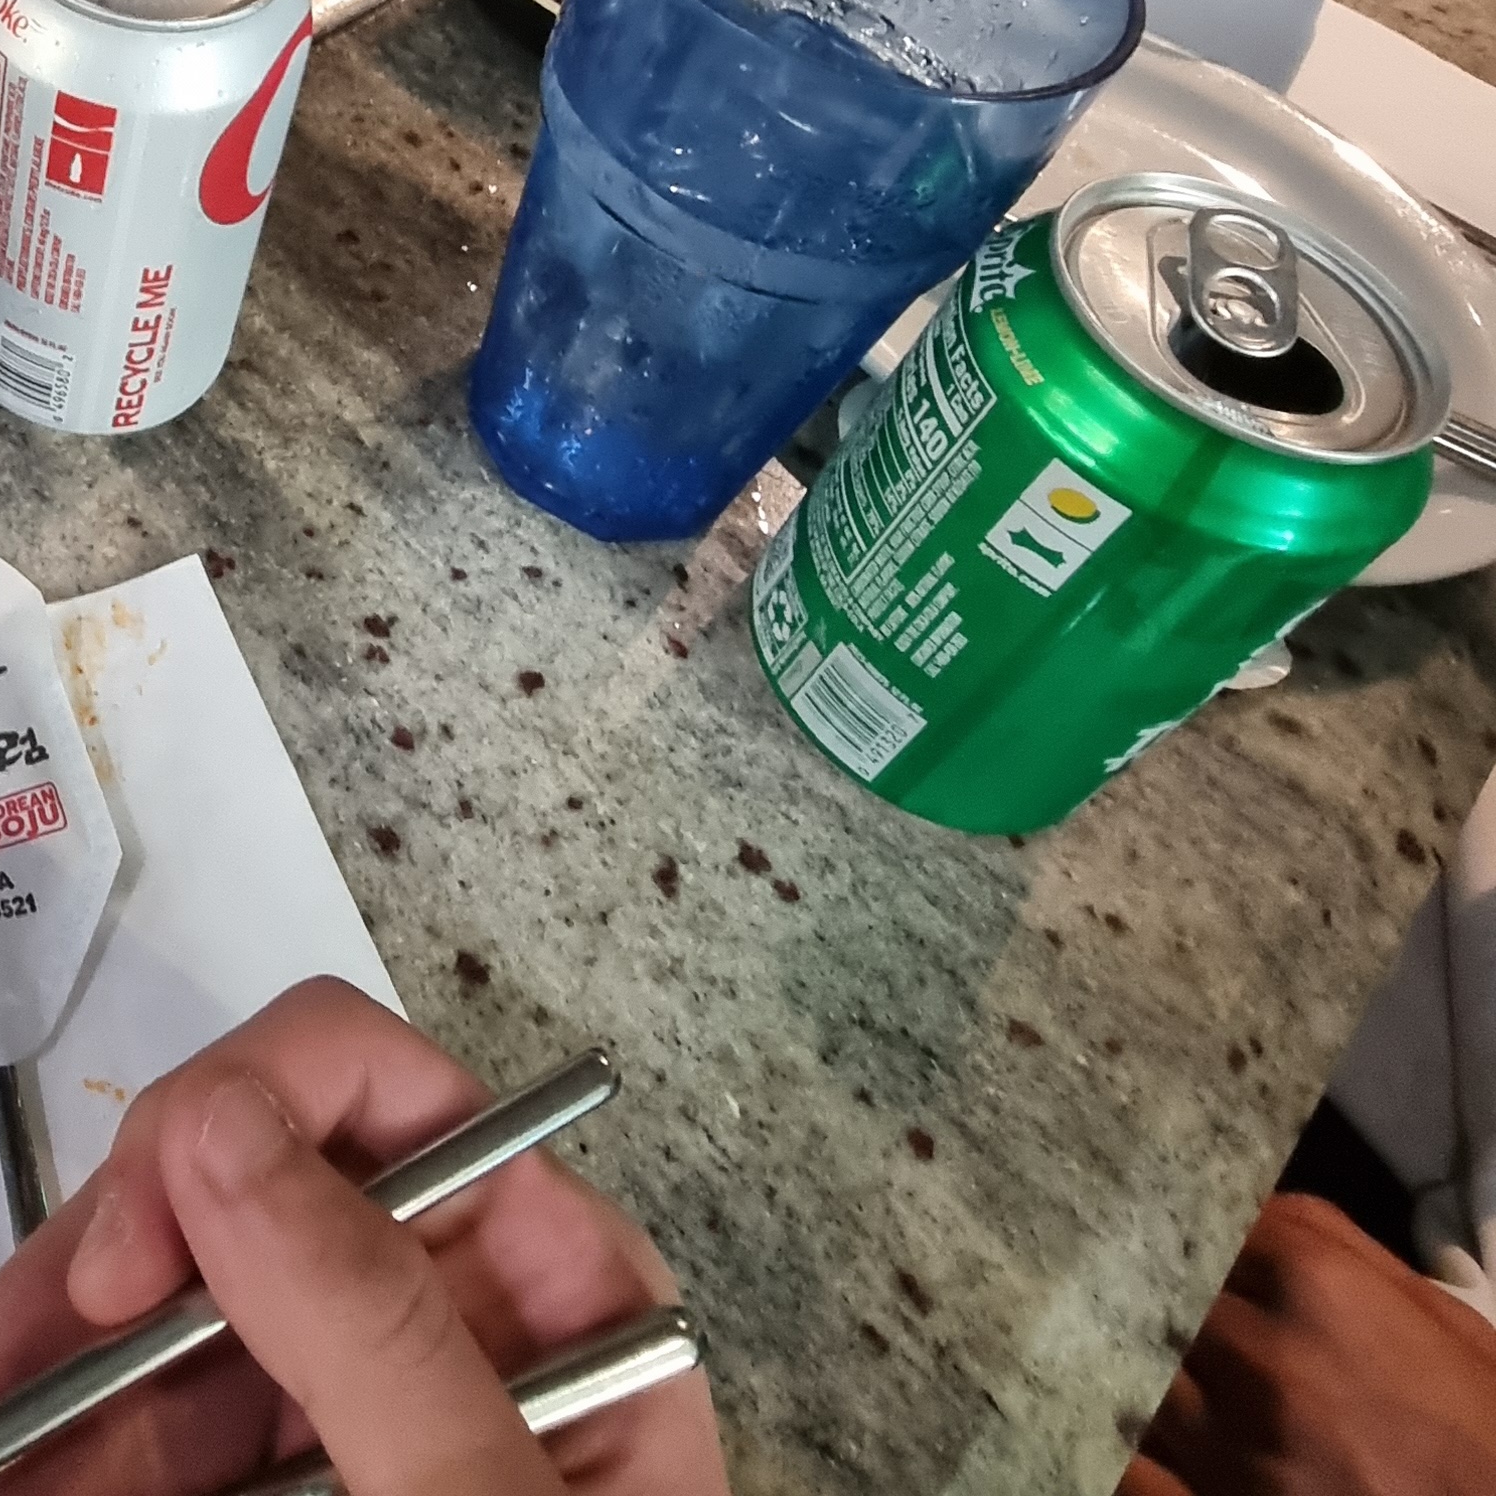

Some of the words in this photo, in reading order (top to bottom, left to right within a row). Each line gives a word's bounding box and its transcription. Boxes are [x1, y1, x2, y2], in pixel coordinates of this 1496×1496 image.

[135, 264, 173, 309] ME
[111, 313, 163, 428] RECYCLE
[951, 343, 985, 410] Facts
[913, 398, 949, 462] 140
